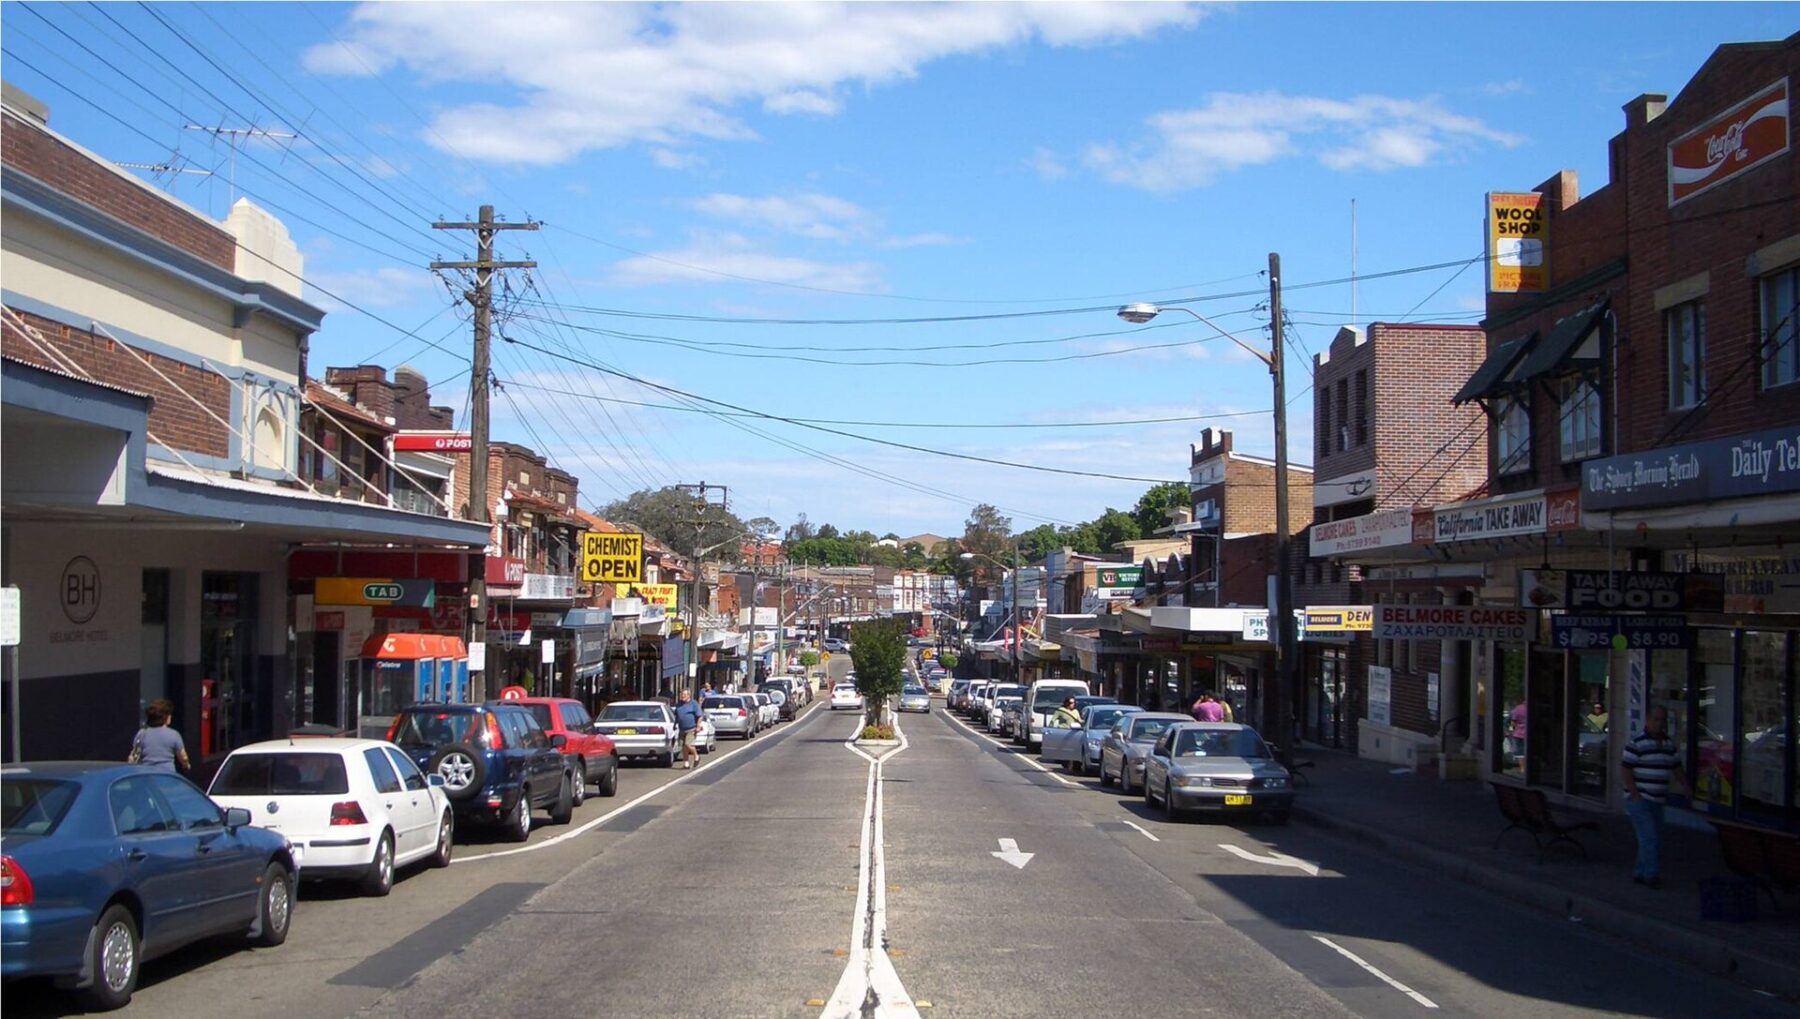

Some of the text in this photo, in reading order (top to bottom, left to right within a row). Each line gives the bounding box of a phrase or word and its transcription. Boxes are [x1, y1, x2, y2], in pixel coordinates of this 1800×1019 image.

[1495, 207, 1543, 220] WOOL
[1498, 221, 1541, 234] SHOP
[446, 438, 472, 448] POST
[1731, 441, 1773, 484] Daily
[1589, 453, 1699, 494] The Sydney Morning Herald
[1339, 519, 1357, 538] CAKES
[1437, 501, 1543, 541] California TAKE AWAY
[587, 536, 639, 556] CHEMIST
[510, 562, 524, 581] POST
[588, 559, 637, 578] OPEN
[1103, 574, 1116, 582] VB
[1574, 573, 1679, 590] TAKE AWAY
[67, 574, 96, 605] BH
[369, 586, 399, 598] TAB
[1571, 588, 1680, 609] FOOD
[1383, 607, 1528, 625] BELMORE CAKES
[50, 629, 108, 643] BELMORE HOTEL
[1631, 630, 1680, 647] $8.90
